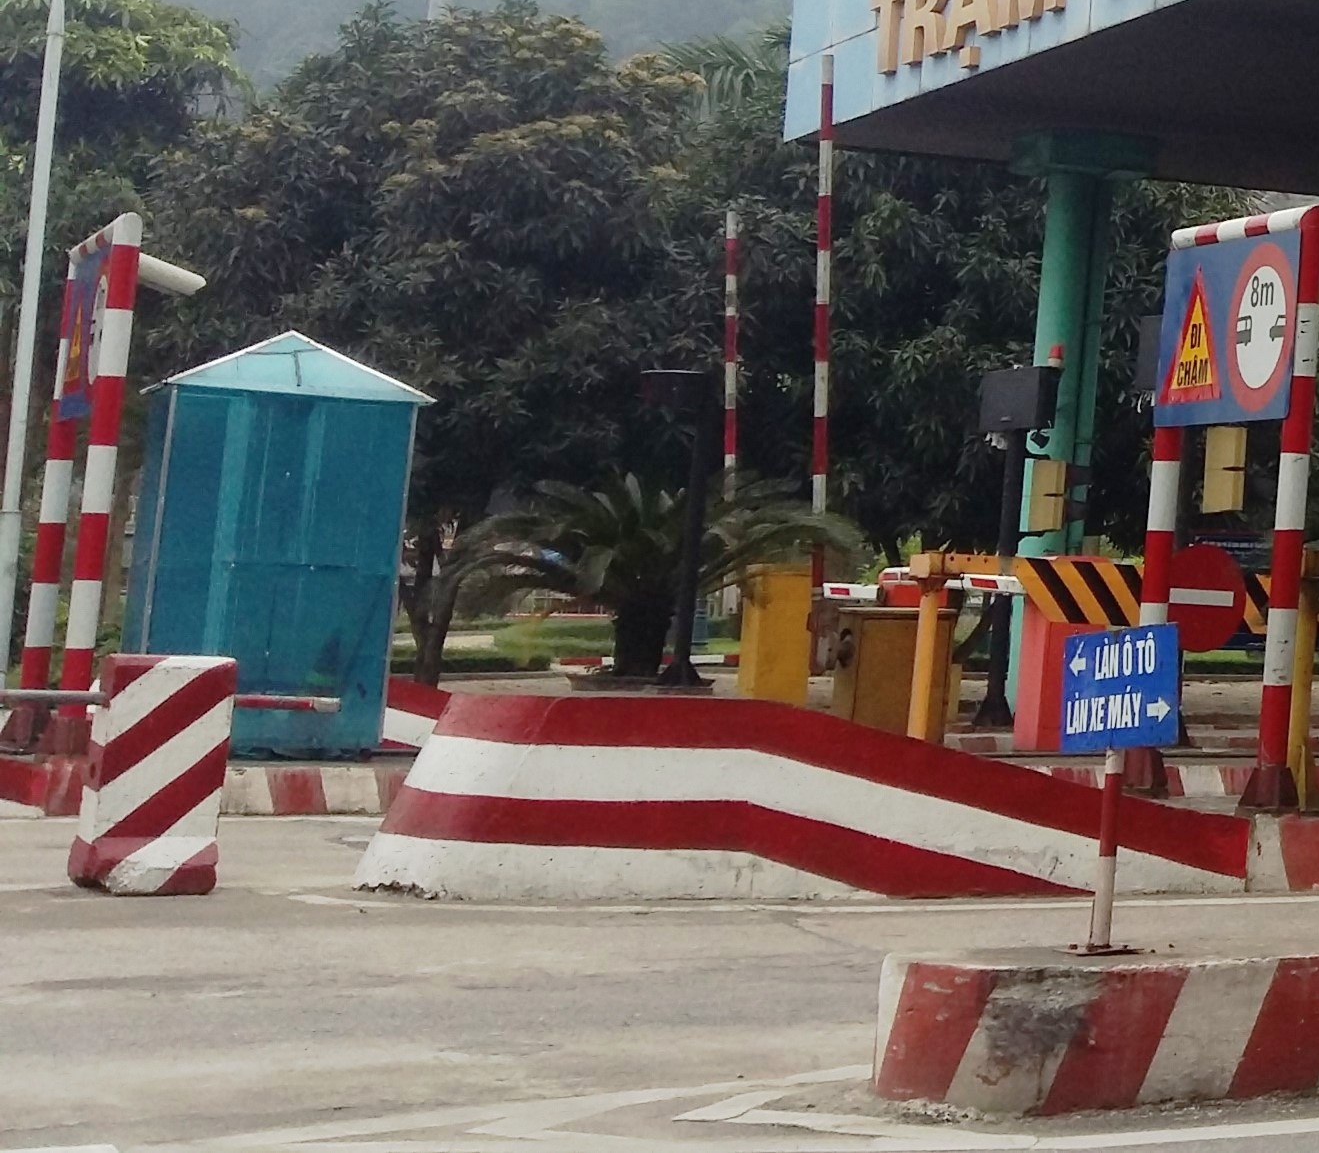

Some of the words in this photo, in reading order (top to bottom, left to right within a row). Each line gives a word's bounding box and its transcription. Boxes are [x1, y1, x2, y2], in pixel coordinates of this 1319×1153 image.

[1250, 276, 1275, 308] 8m
[1190, 323, 1202, 350] ĐI
[1094, 637, 1119, 681] LÀN
[1122, 634, 1133, 677] Ô
[1136, 631, 1156, 675] TÔ
[1066, 691, 1088, 735] LÀN
[1089, 697, 1106, 732] XE
[1107, 685, 1142, 730] MÁY
